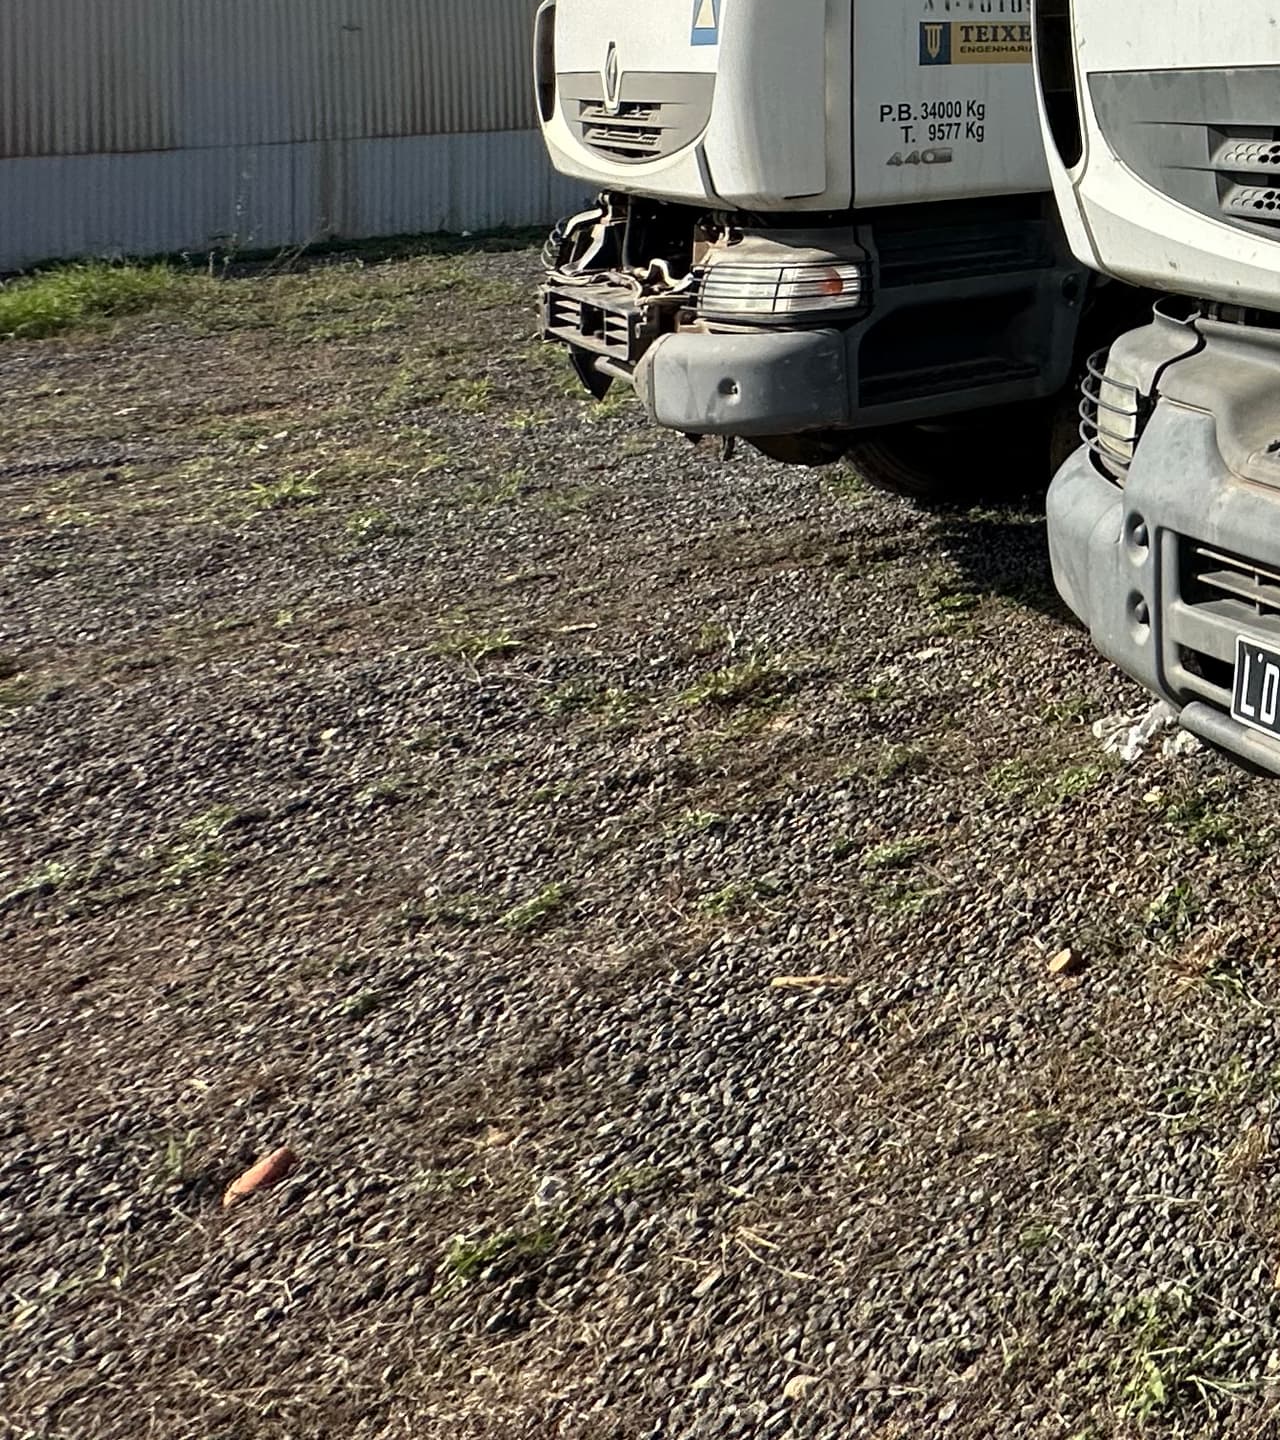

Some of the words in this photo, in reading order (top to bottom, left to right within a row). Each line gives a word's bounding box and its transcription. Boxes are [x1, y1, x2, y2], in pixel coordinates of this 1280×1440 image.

[880, 104, 918, 122] P.B.
[921, 101, 962, 120] 34000
[966, 100, 985, 121] Kg
[900, 125, 916, 143] T.
[928, 123, 961, 141] 9577
[966, 122, 984, 142] Kg
[886, 147, 952, 166] 440
